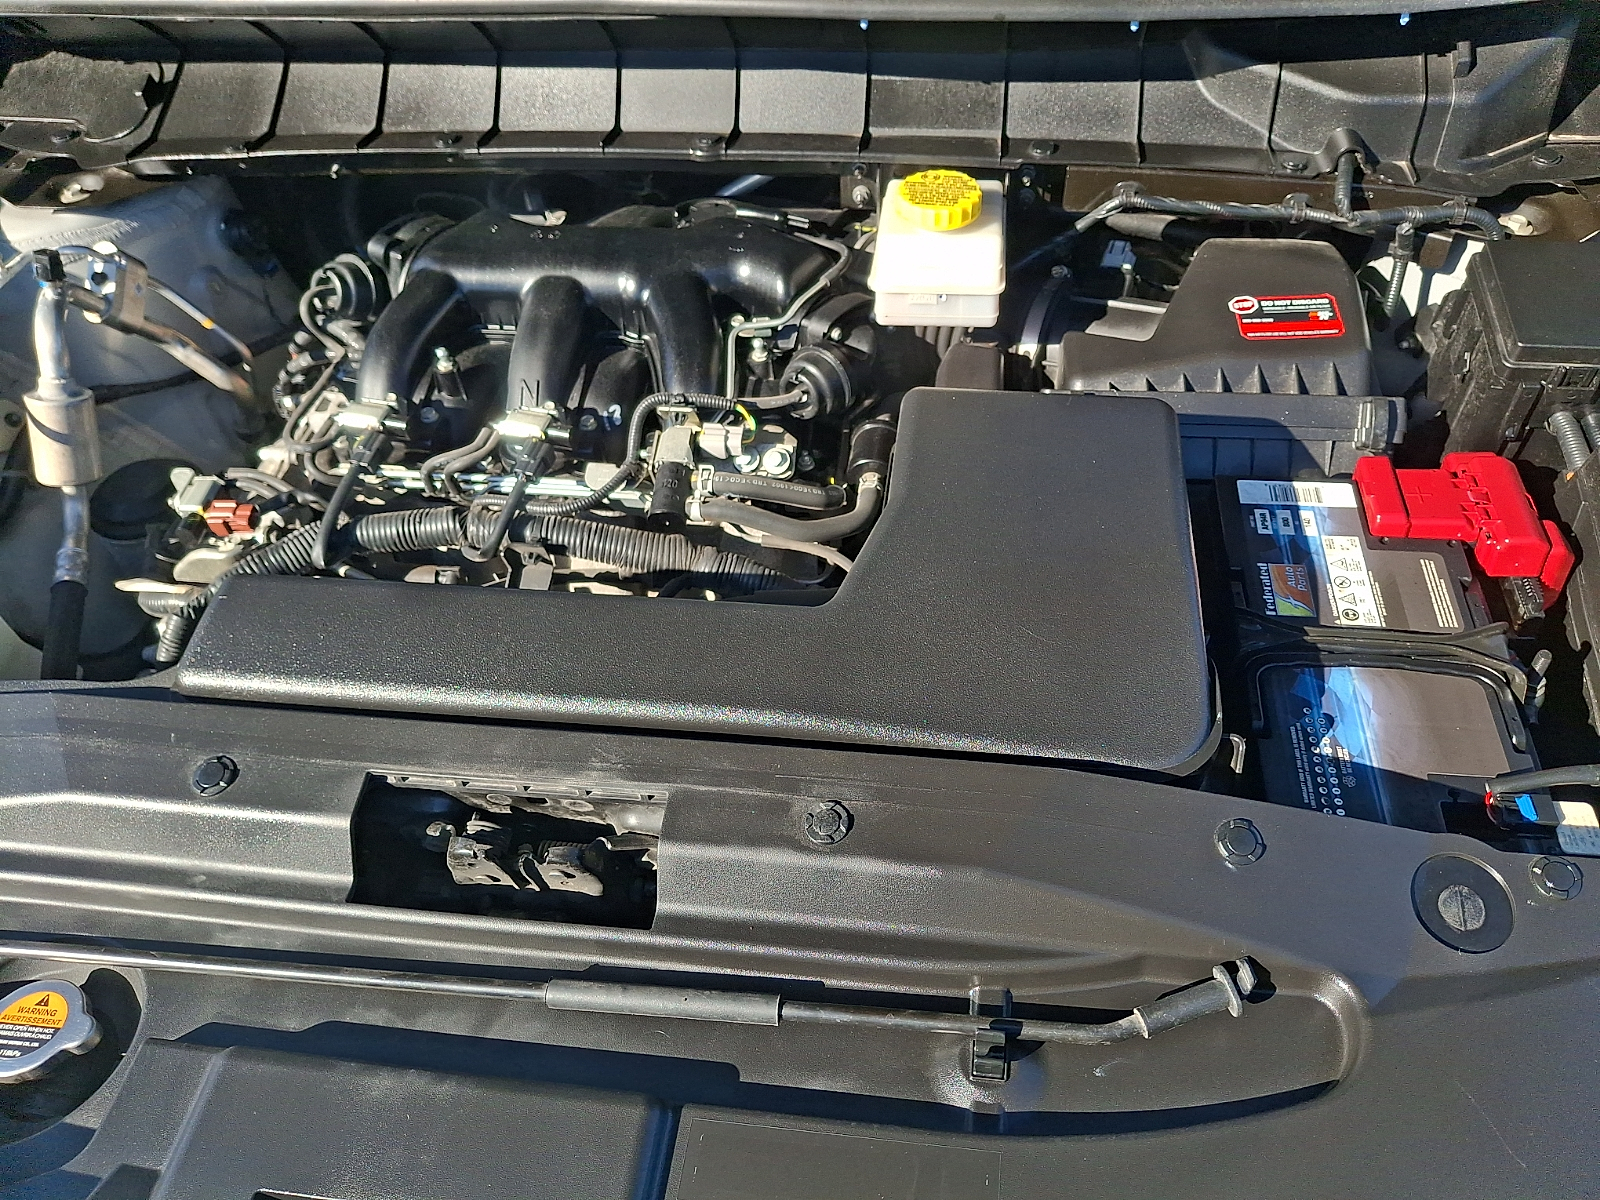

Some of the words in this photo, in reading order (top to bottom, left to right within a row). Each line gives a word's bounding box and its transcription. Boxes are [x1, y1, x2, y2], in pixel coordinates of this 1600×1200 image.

[1285, 566, 1297, 587] Auto
[1296, 567, 1308, 591] Parts
[1257, 562, 1277, 616] Federated
[1, 1014, 62, 1026] AVERTISSEMENT
[17, 1006, 58, 1017] WARNING
